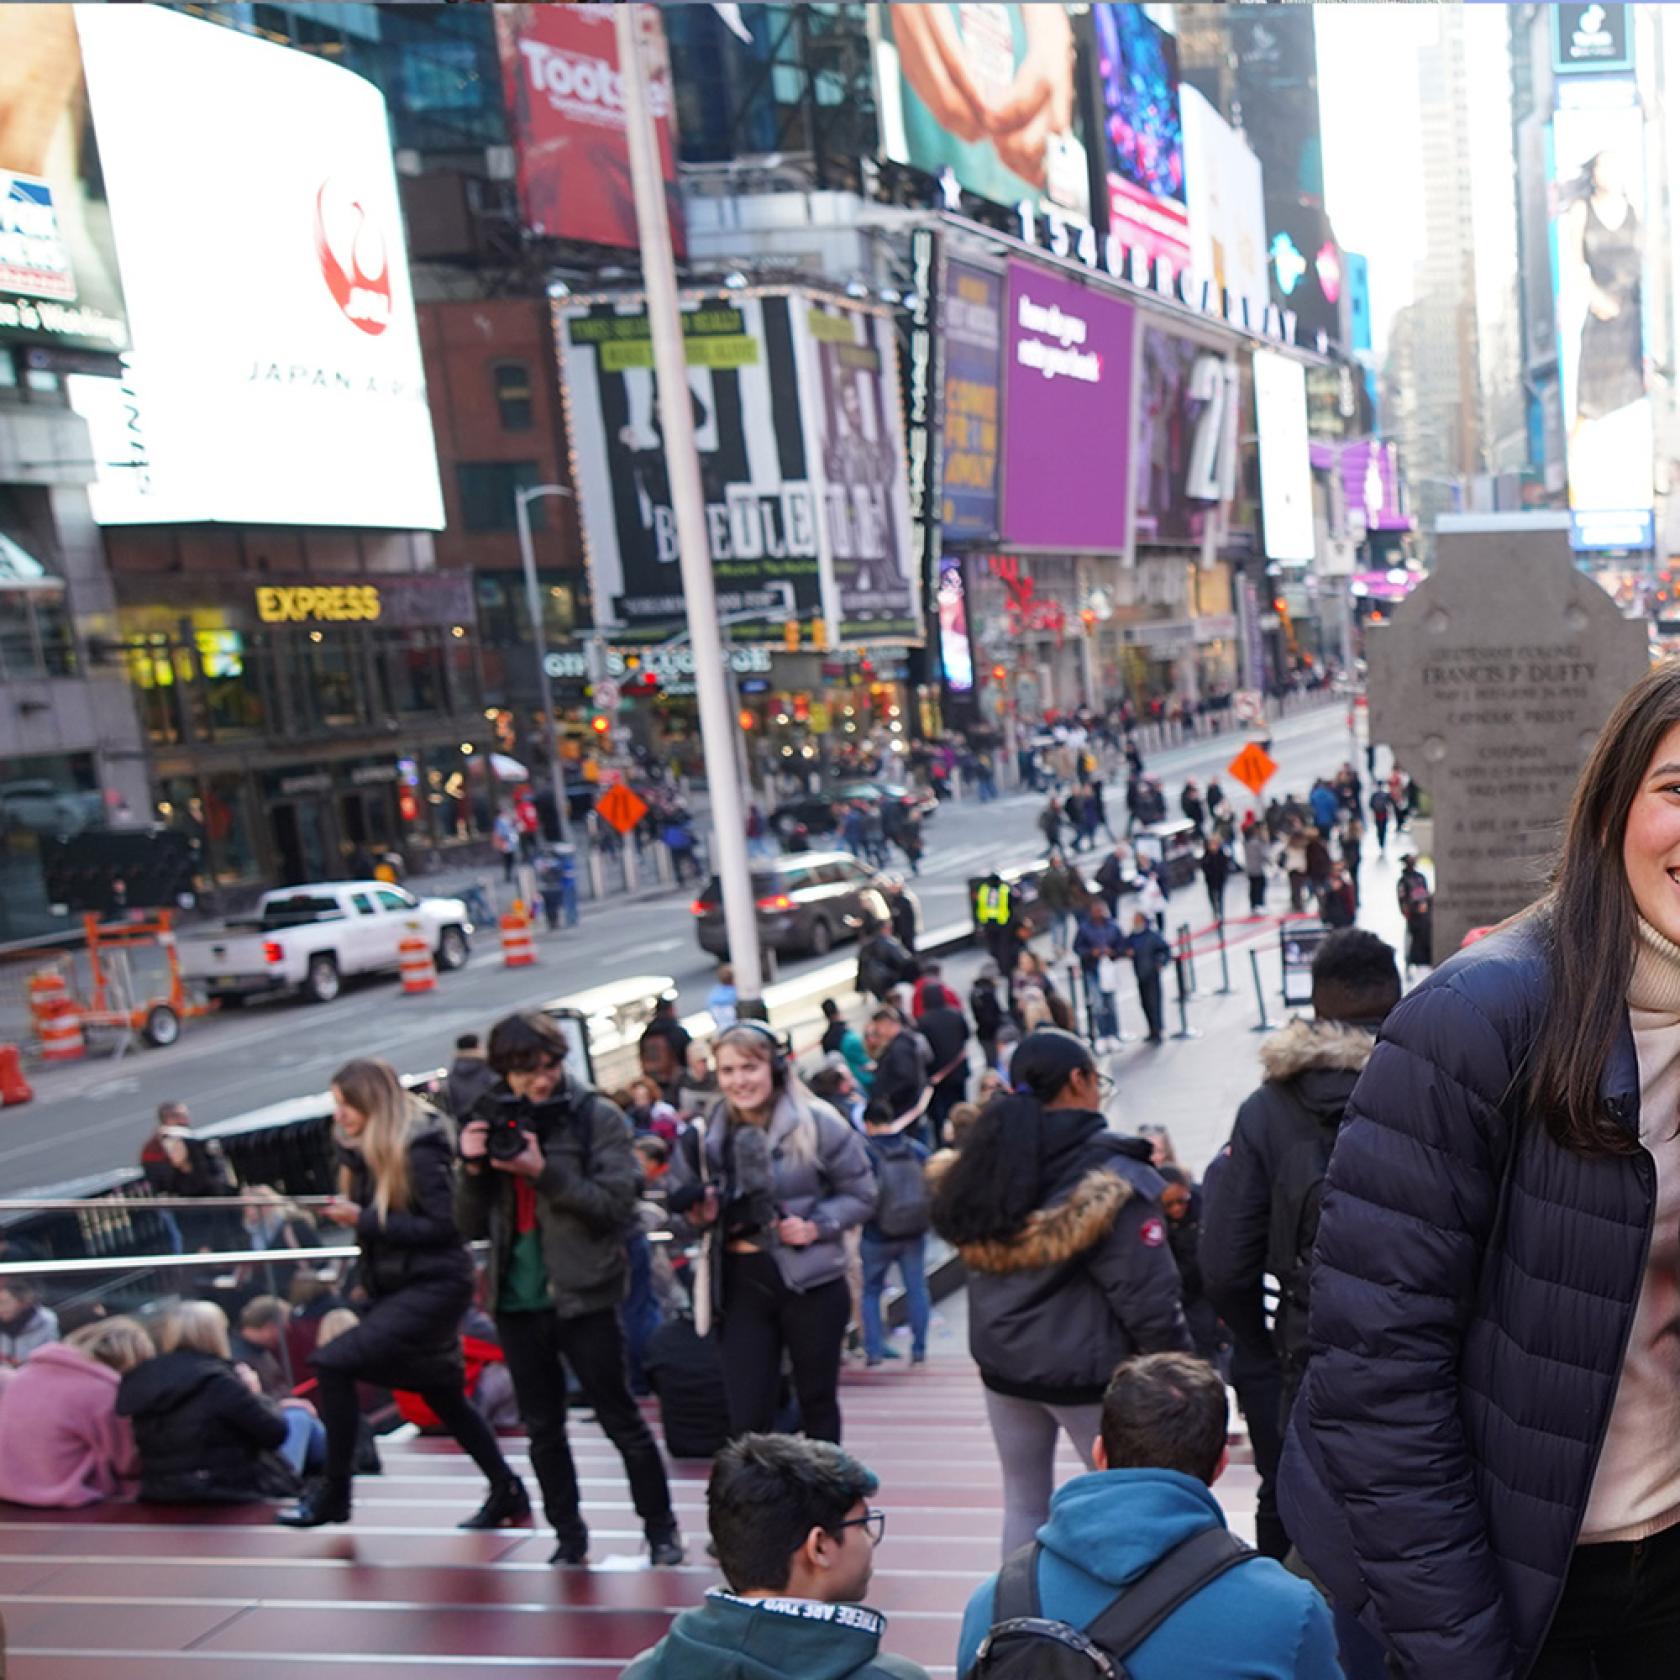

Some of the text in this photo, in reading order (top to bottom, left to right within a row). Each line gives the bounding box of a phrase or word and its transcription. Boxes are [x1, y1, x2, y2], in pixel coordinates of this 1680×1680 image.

[249, 361, 351, 390] JAPAN
[255, 584, 381, 622] EXPRESS
[1422, 664, 1504, 686] FRANCIS
[1527, 662, 1598, 683] DUFFY
[802, 1602, 835, 1623] ARE
[834, 1605, 879, 1634] THERE
